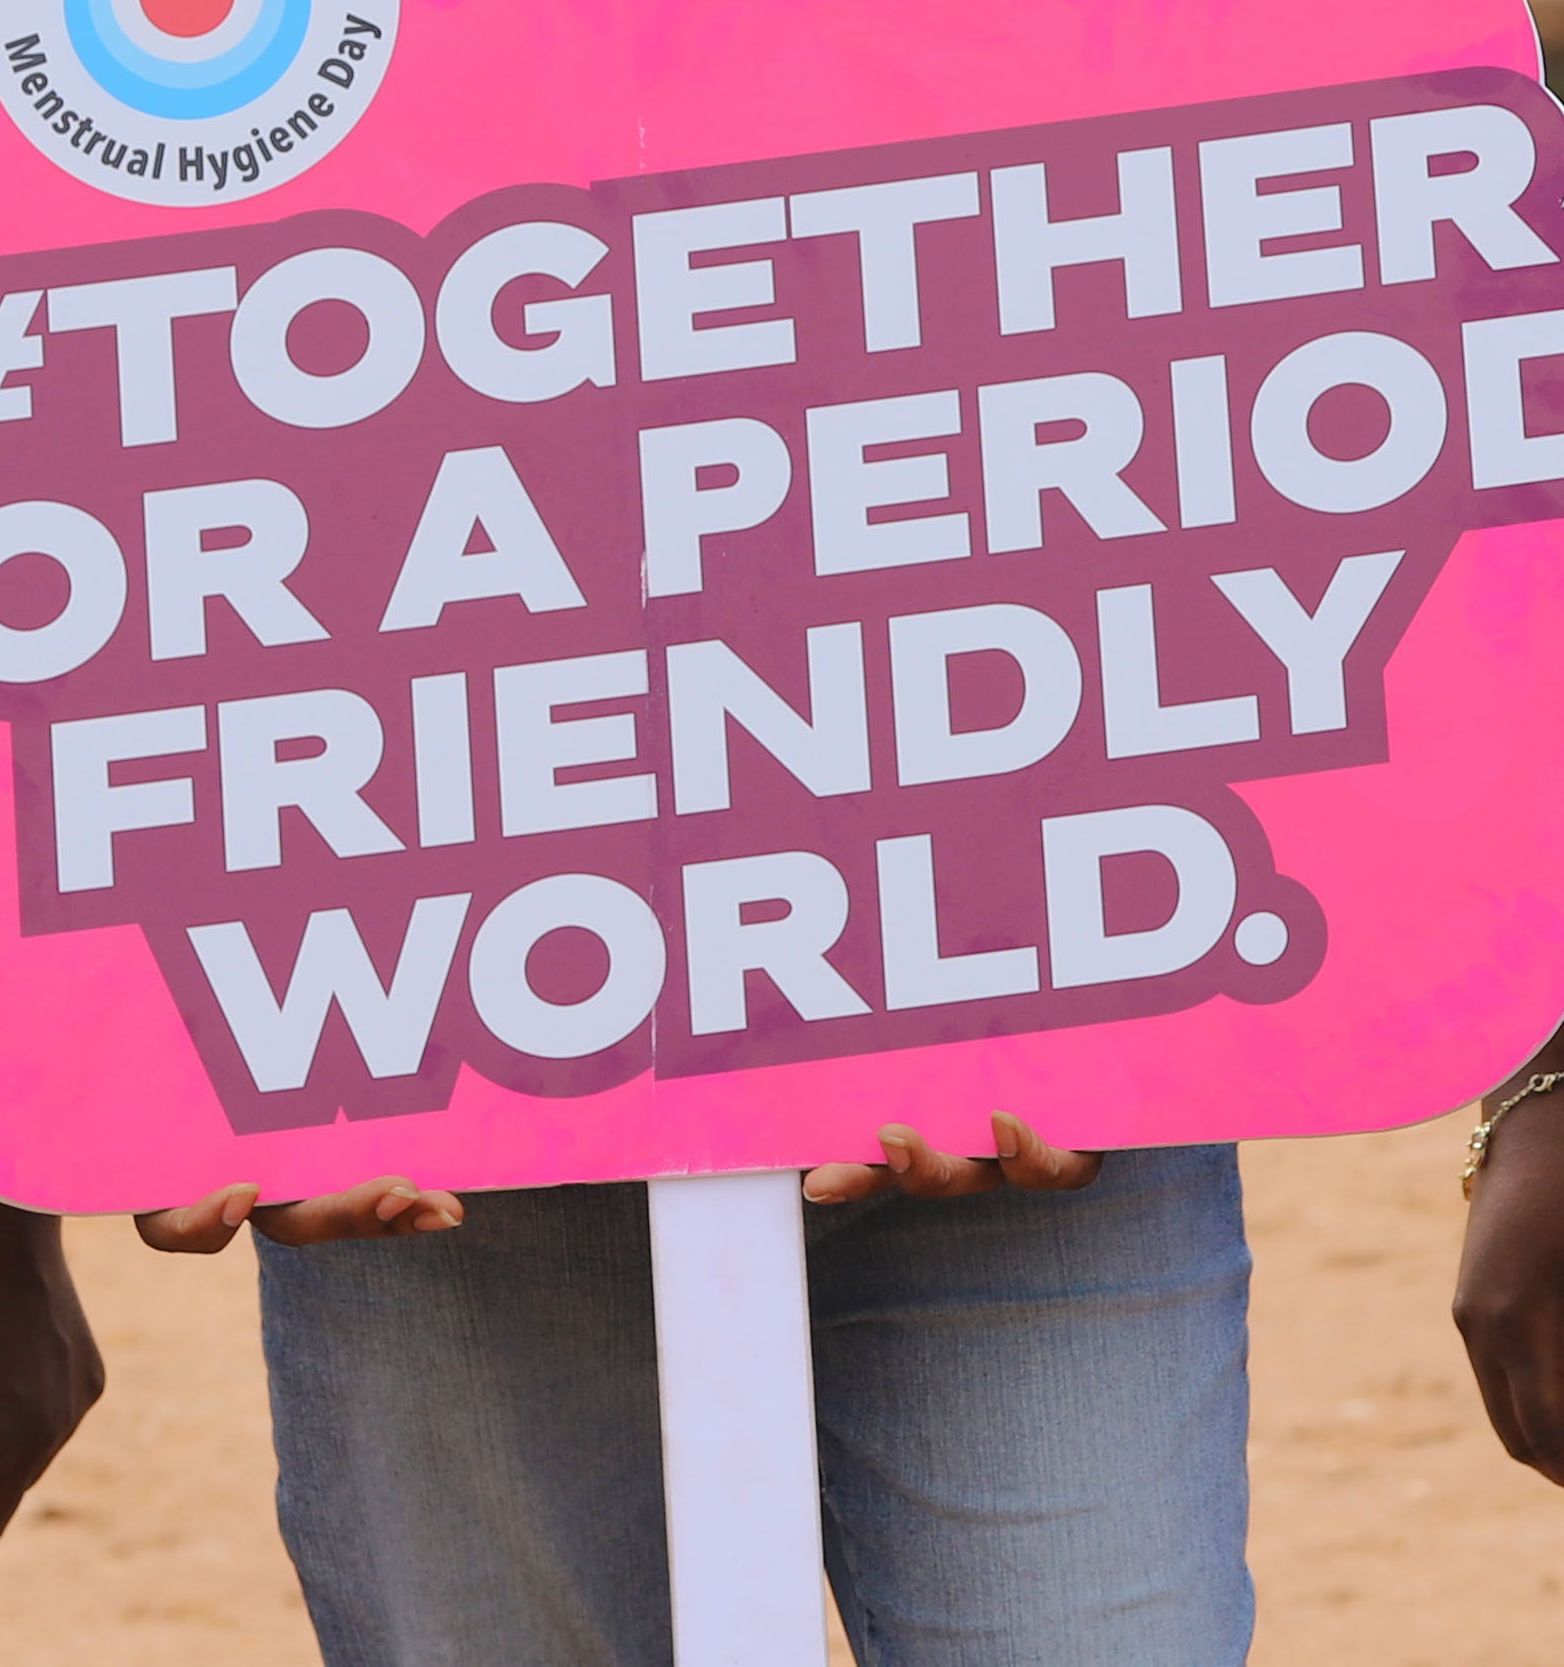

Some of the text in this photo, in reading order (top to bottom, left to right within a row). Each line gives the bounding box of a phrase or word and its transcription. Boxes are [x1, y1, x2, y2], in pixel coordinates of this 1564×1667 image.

[3, 13, 383, 190] Menstrual Hygiene Day
[380, 446, 586, 632] A
[52, 552, 1404, 892] FRIENDLY
[189, 804, 1288, 1093] WORLD.
